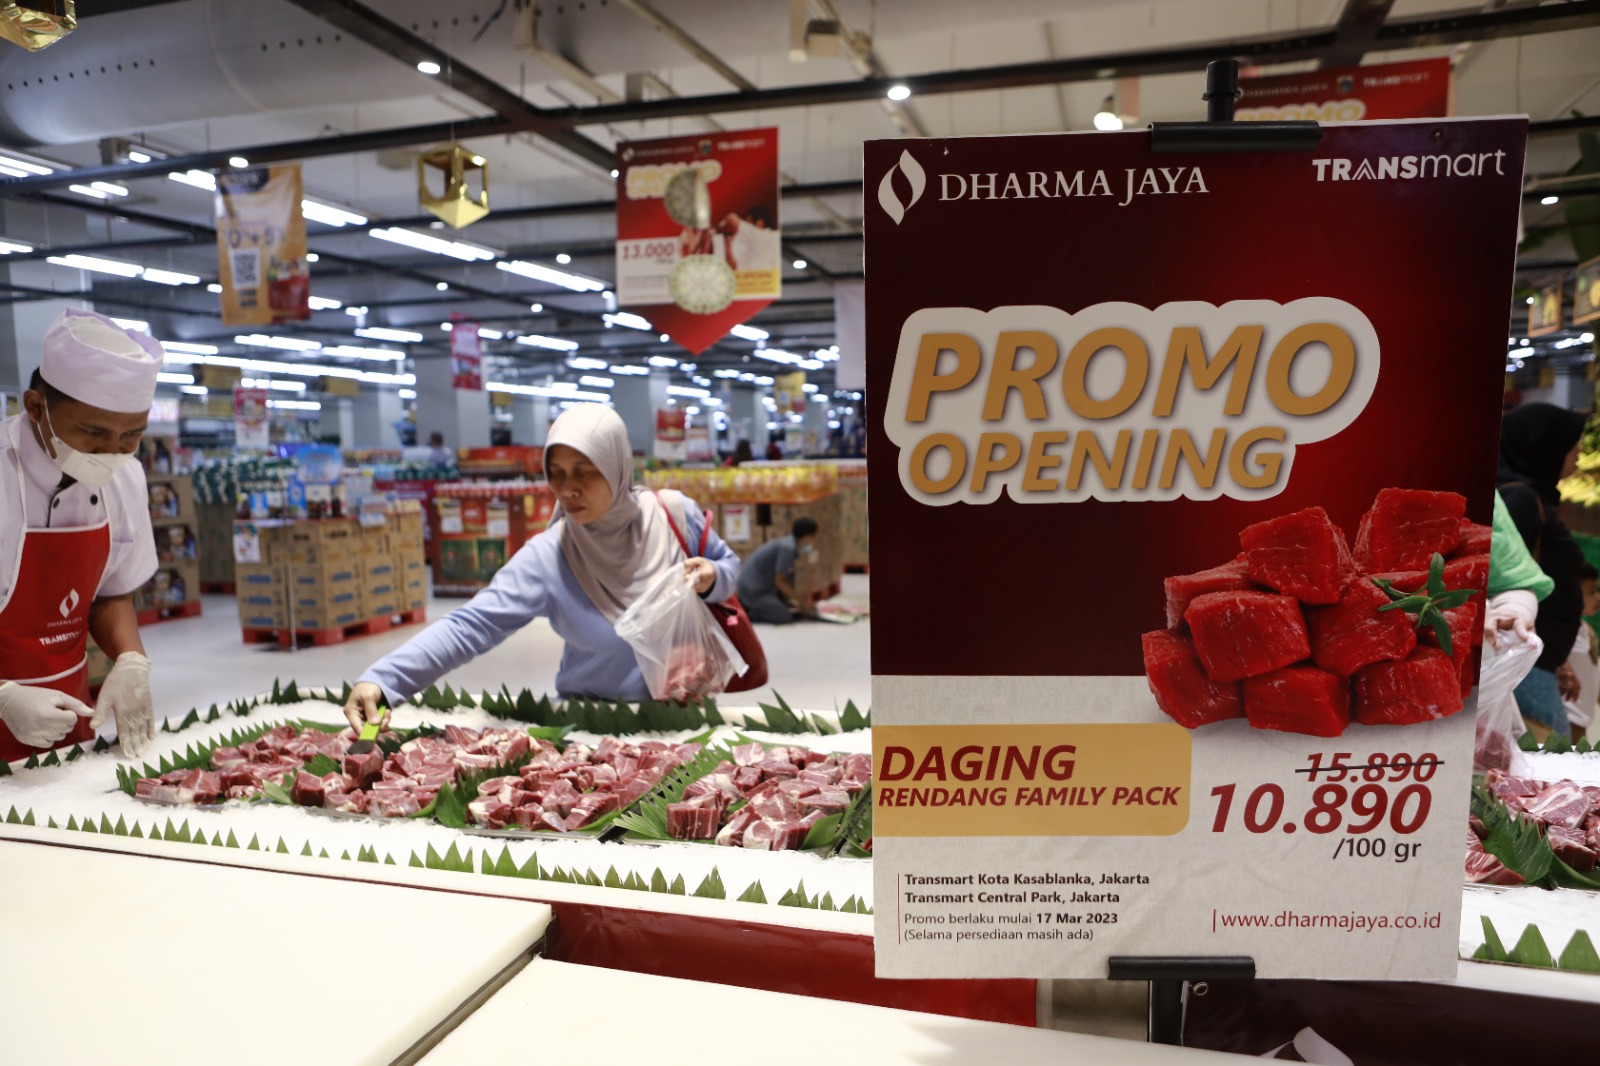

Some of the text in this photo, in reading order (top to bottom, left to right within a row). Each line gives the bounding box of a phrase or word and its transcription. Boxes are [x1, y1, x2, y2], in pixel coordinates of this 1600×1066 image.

[1312, 149, 1506, 182] TRANSmart
[938, 166, 1211, 207] DHARMA JAYA
[905, 321, 1356, 423] PROMO
[908, 426, 1288, 495] OPENING
[879, 744, 1077, 782] DAGING
[1306, 752, 1439, 783] 15.890
[879, 786, 1182, 807] RENDANG FAMILY PACK
[1210, 783, 1433, 835] 10.890
[1332, 838, 1423, 863] /100 gr
[904, 873, 1150, 886] Transmart Kota Kasablanka, Jakarta
[904, 891, 1120, 905] Transmart Central Park, Jakarta
[904, 912, 1118, 925] Promo berlaku mulai 17 Mar 2023
[1221, 910, 1441, 933] www.dharmajaya.co.id
[904, 929, 1094, 943] (Selama persediaan masih ada)
